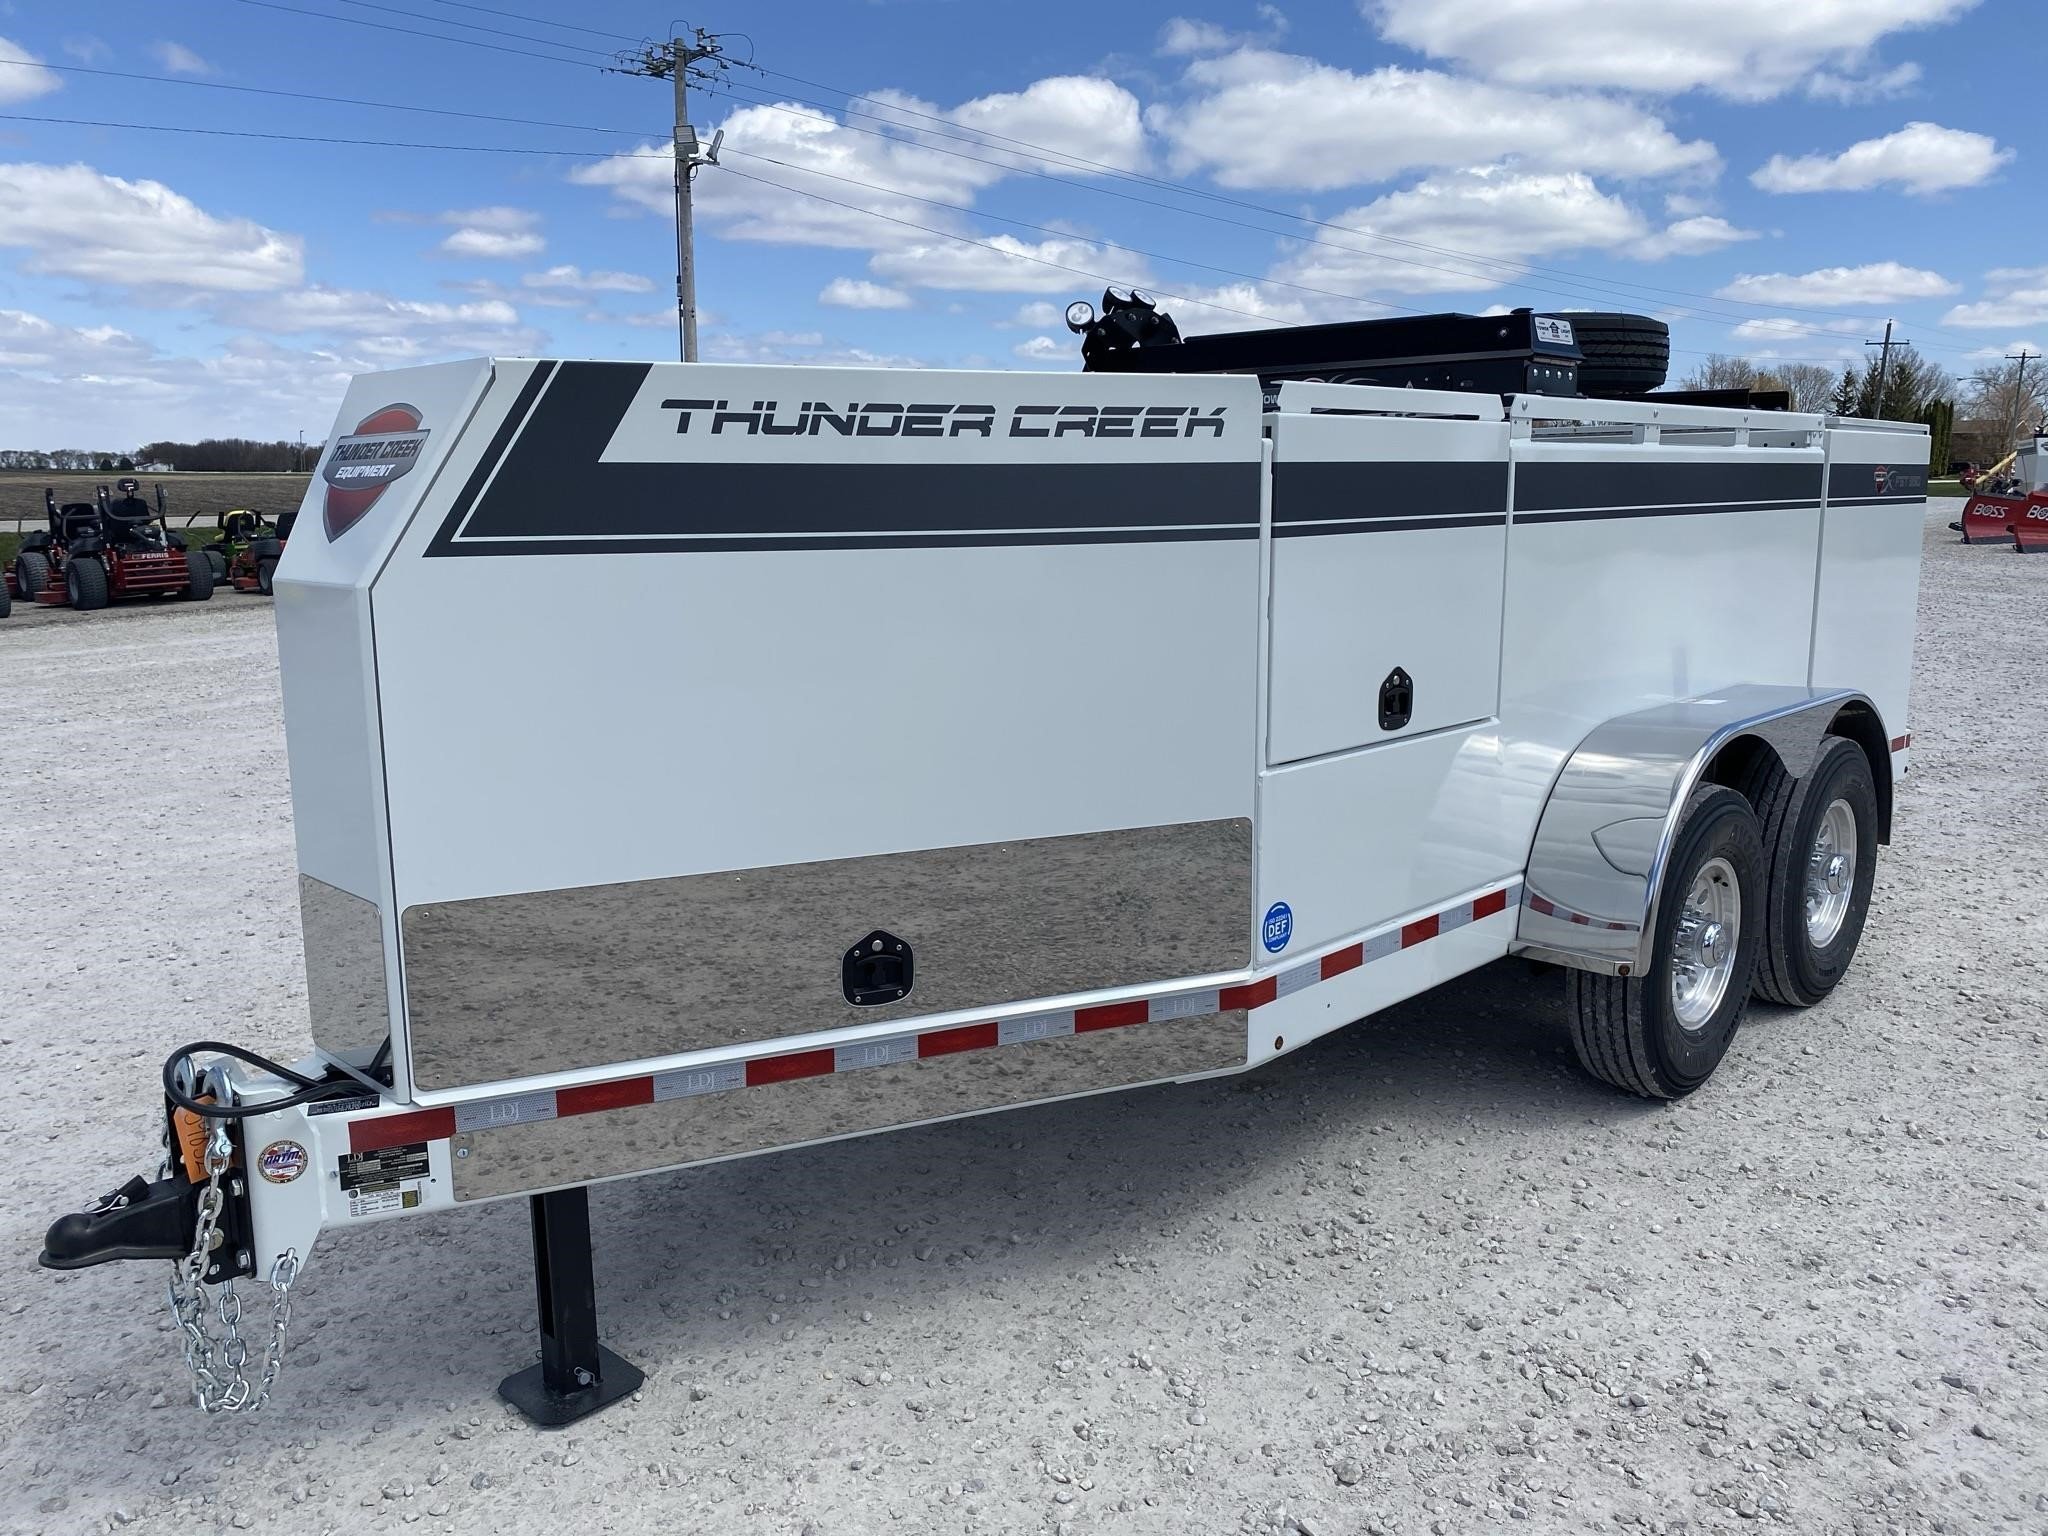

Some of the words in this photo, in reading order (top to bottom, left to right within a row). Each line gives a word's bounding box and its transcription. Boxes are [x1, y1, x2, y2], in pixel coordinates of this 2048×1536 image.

[661, 399, 996, 437] THUNDER
[1008, 404, 1228, 438] CREEK
[331, 441, 385, 461] THUNDER
[379, 439, 424, 459] CREEK
[334, 464, 396, 479] EQUIPMENT
[1972, 503, 2009, 518] BOSS
[2026, 504, 2048, 521] BO
[1268, 919, 1288, 938] DEF
[688, 1072, 715, 1090] LDJ
[490, 1102, 520, 1121] LDJ
[347, 1152, 364, 1163] LDJ
